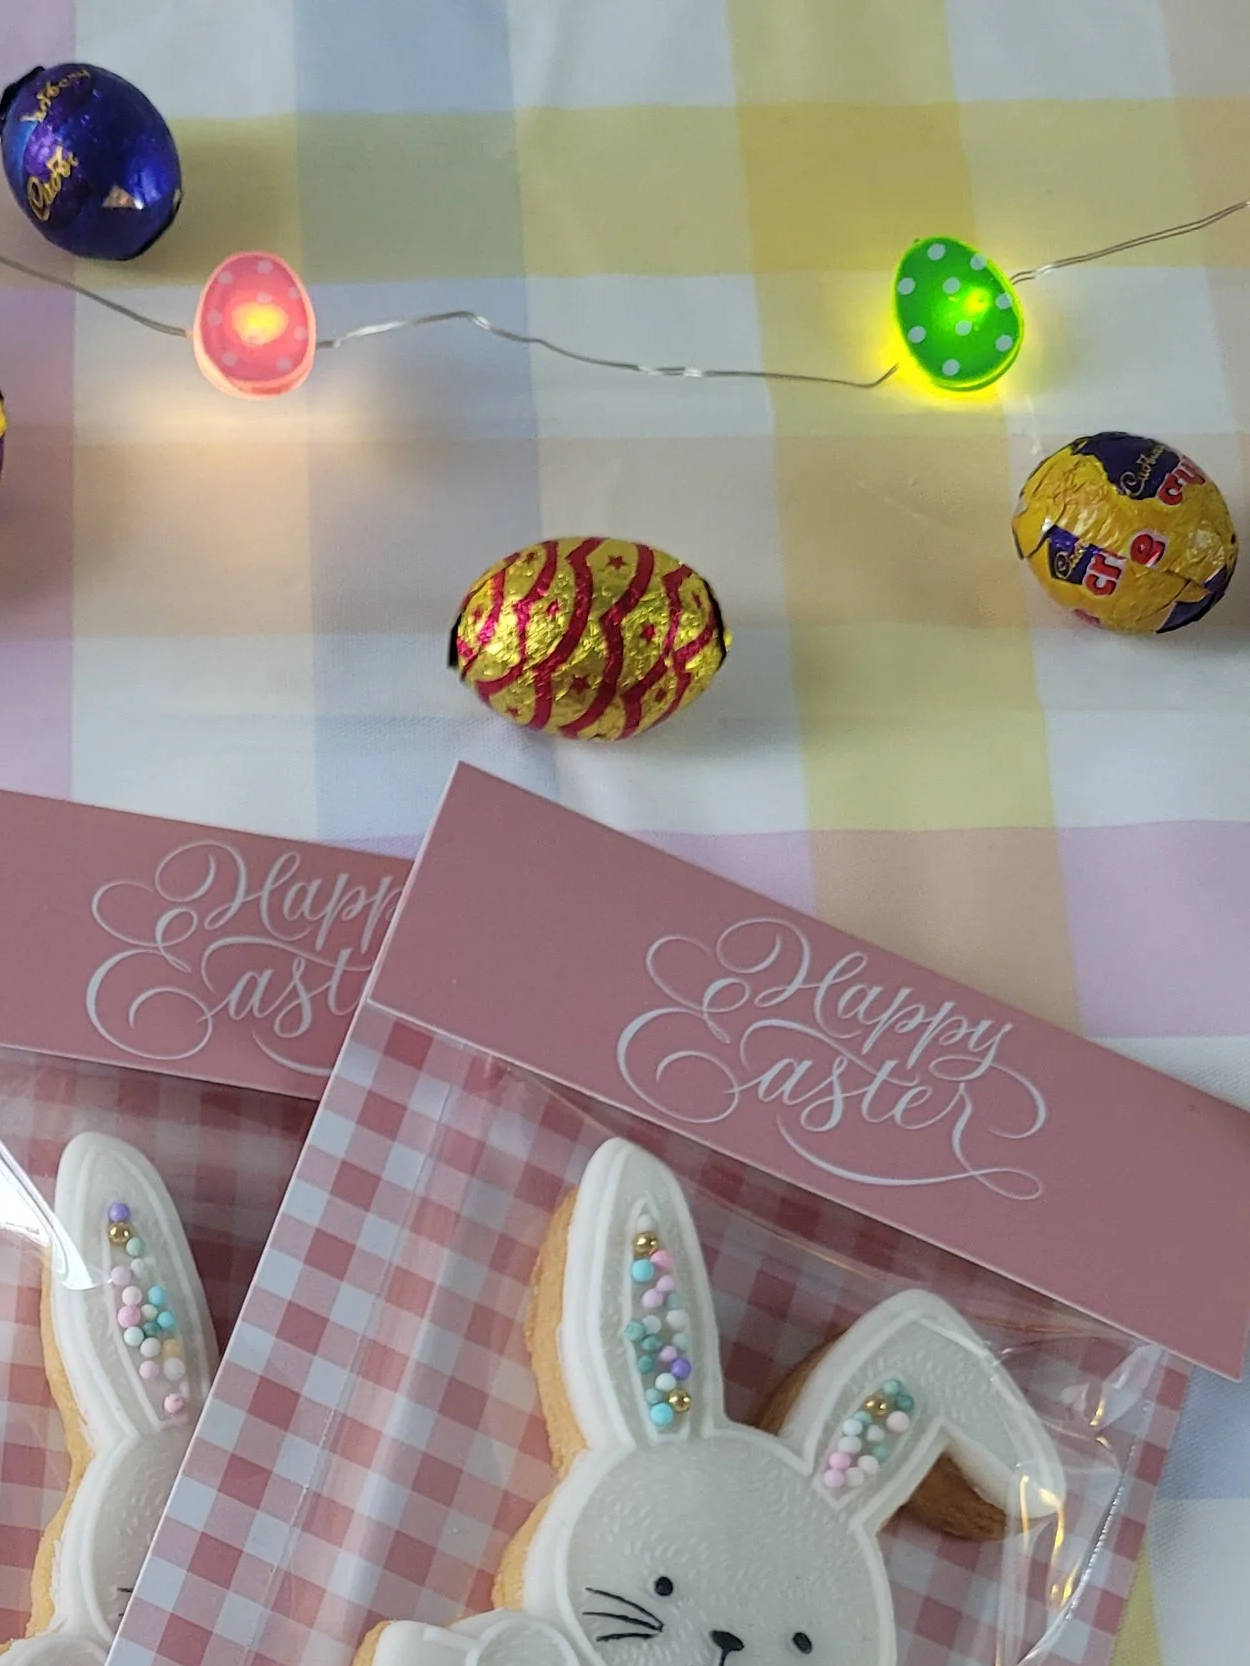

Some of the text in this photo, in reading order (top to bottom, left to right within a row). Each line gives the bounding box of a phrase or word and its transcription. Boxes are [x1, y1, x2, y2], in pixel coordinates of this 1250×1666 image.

[86, 880, 375, 1076] East
[155, 841, 405, 953] Happ
[616, 936, 1043, 1200] Easter
[717, 918, 1047, 1139] Happy
